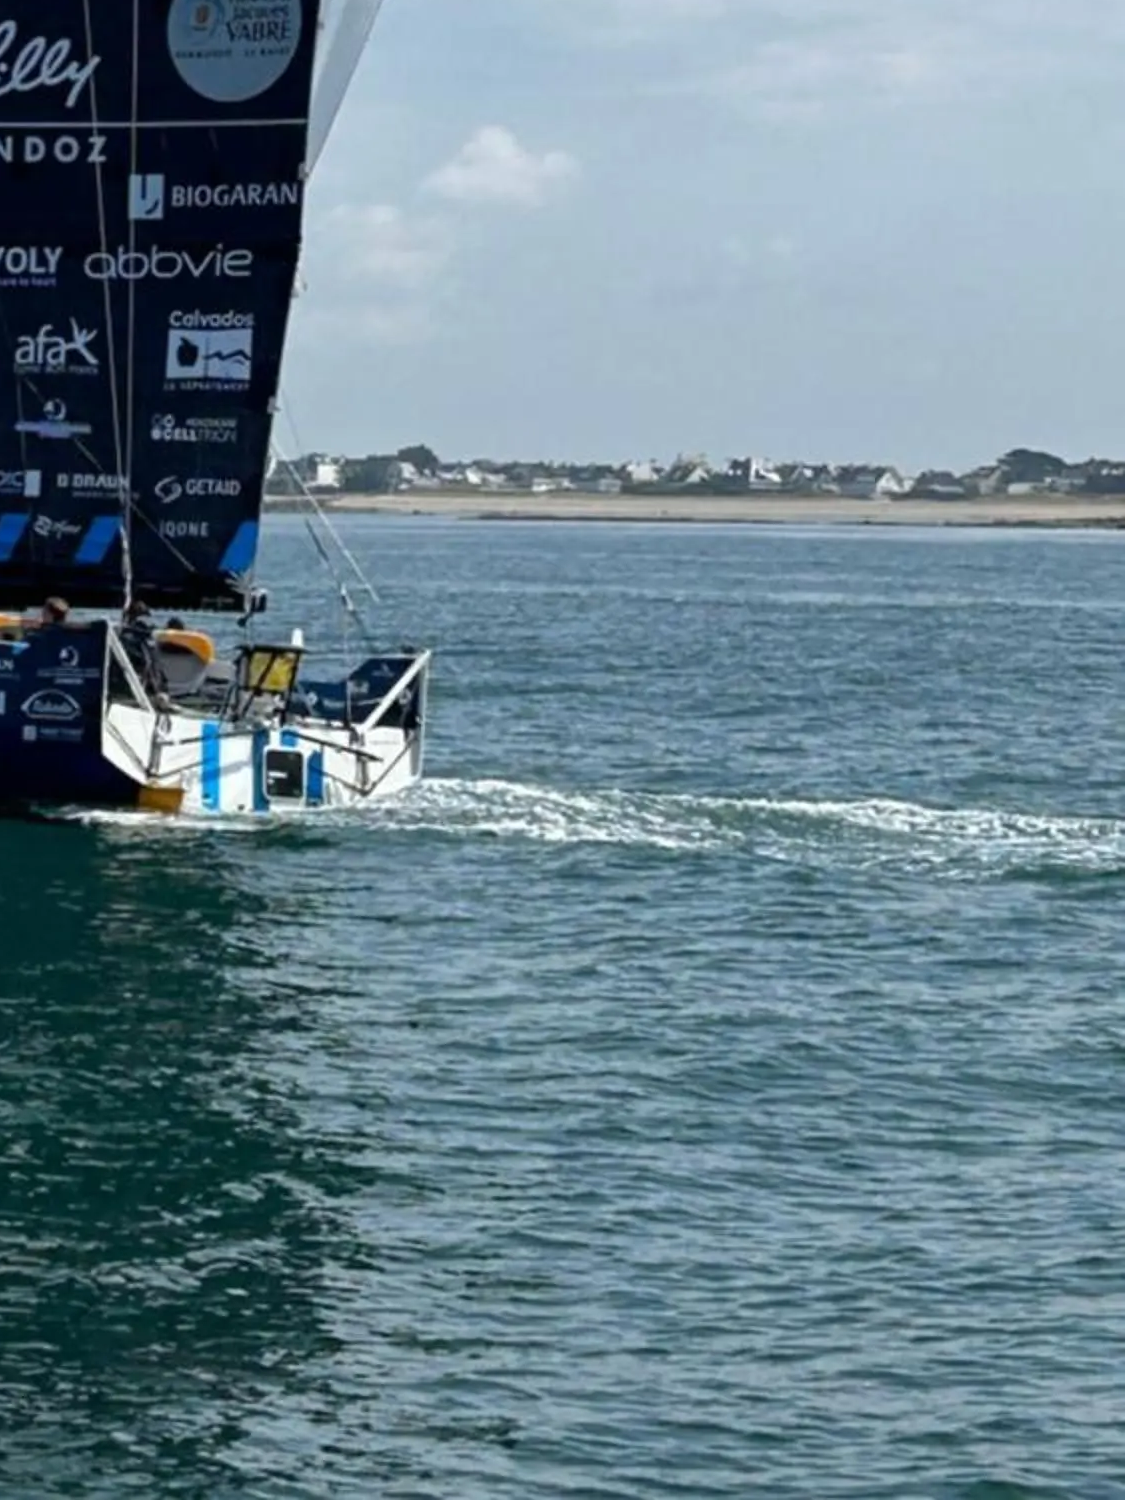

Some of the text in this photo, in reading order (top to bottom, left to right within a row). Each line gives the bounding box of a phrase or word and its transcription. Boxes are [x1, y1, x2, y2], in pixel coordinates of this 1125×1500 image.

[171, 183, 299, 207] BIOGARAN
[83, 243, 253, 279] abbvie
[168, 309, 255, 328] Calvados
[185, 478, 242, 496] GETAID
